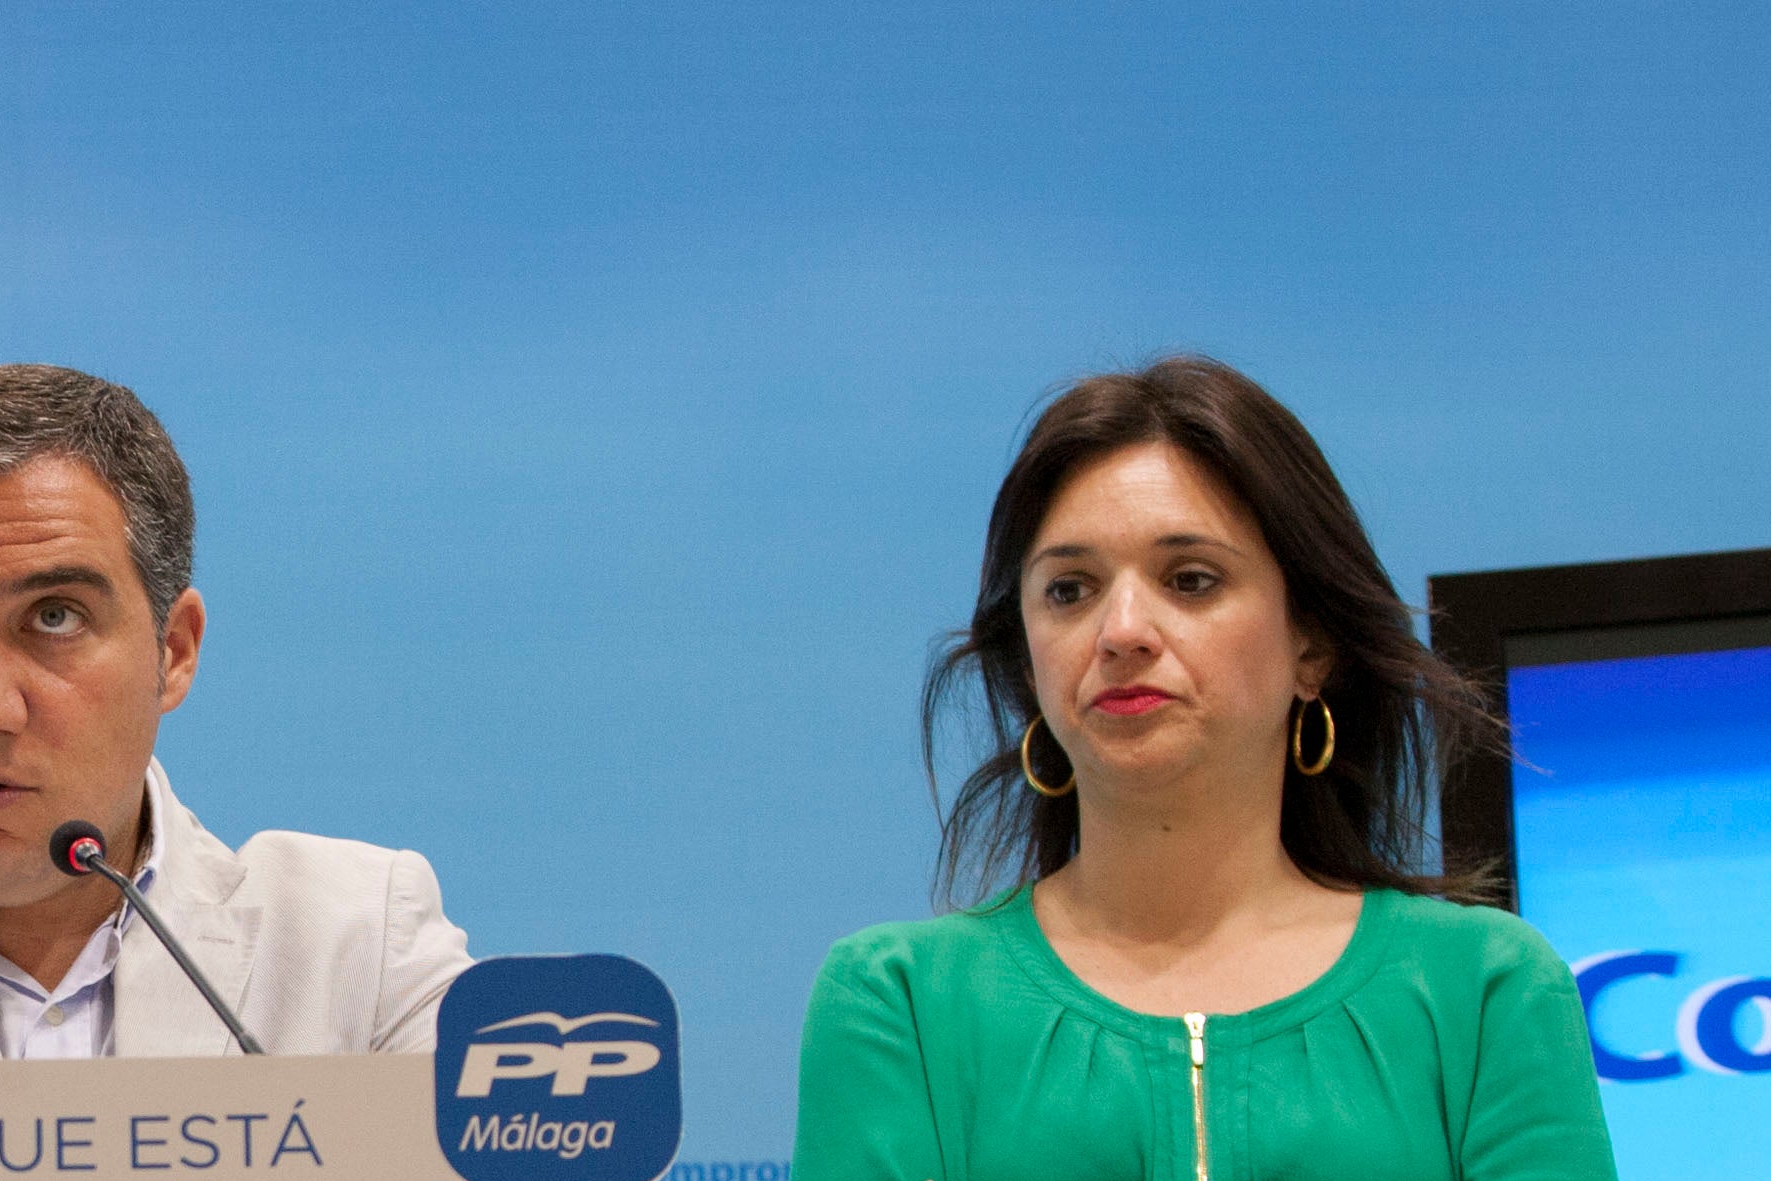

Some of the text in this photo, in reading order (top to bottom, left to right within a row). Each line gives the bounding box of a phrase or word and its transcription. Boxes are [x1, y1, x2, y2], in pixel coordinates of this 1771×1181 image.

[456, 1041, 660, 1097] PP
[130, 1100, 322, 1169] ESTÁ
[459, 1113, 615, 1159] Málaga
